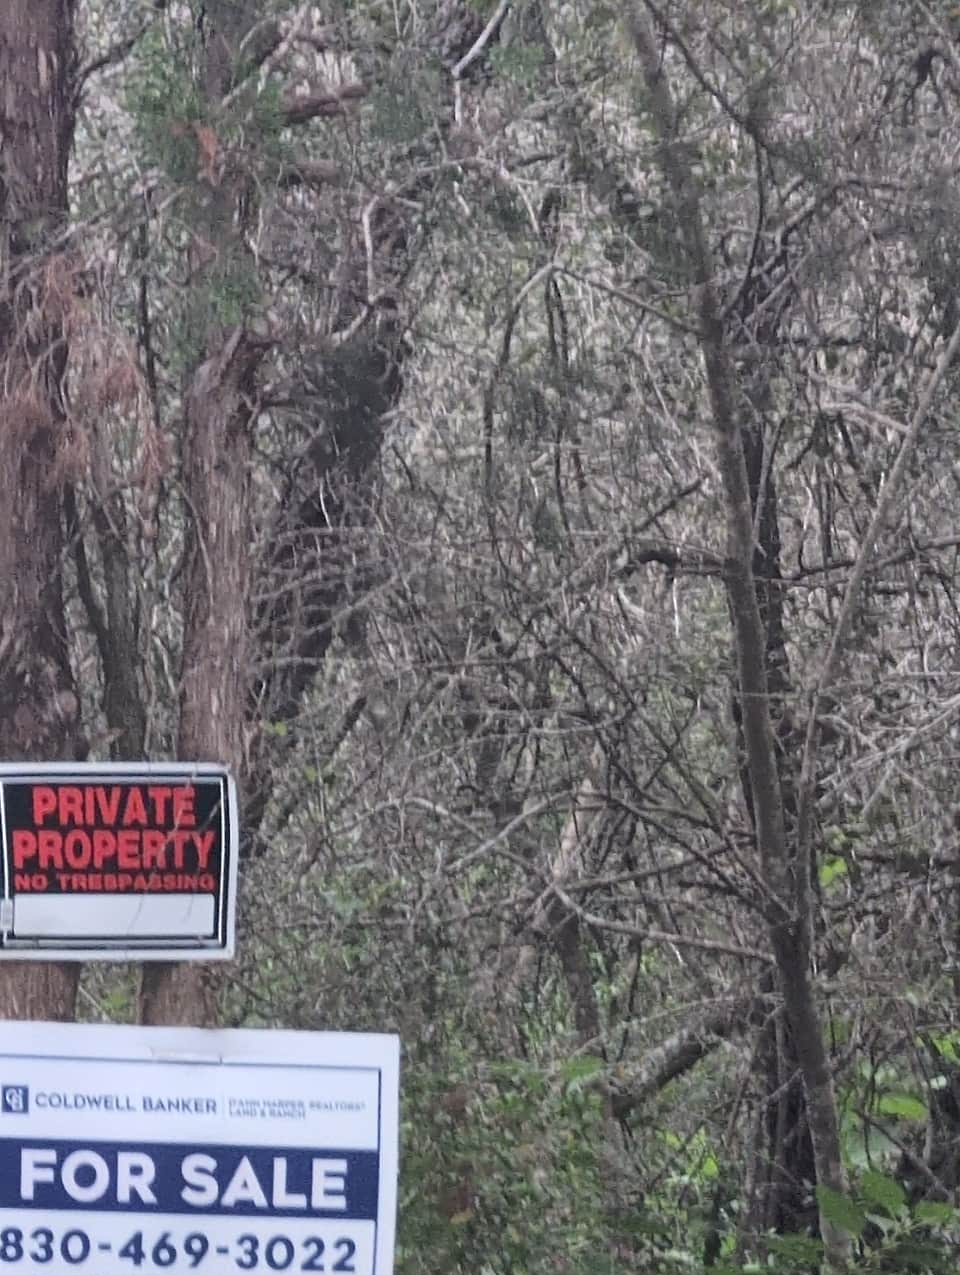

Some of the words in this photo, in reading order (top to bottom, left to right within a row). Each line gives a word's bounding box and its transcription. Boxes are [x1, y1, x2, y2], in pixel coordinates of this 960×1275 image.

[32, 786, 197, 826] PRIVATE
[12, 829, 216, 870] PROPERTY
[14, 873, 48, 890] NO
[57, 873, 215, 891] TRESPASSING
[35, 1092, 136, 1113] COLDWELL
[142, 1094, 218, 1115] BANKER
[20, 1147, 158, 1204] FOR
[181, 1152, 349, 1210] SALE
